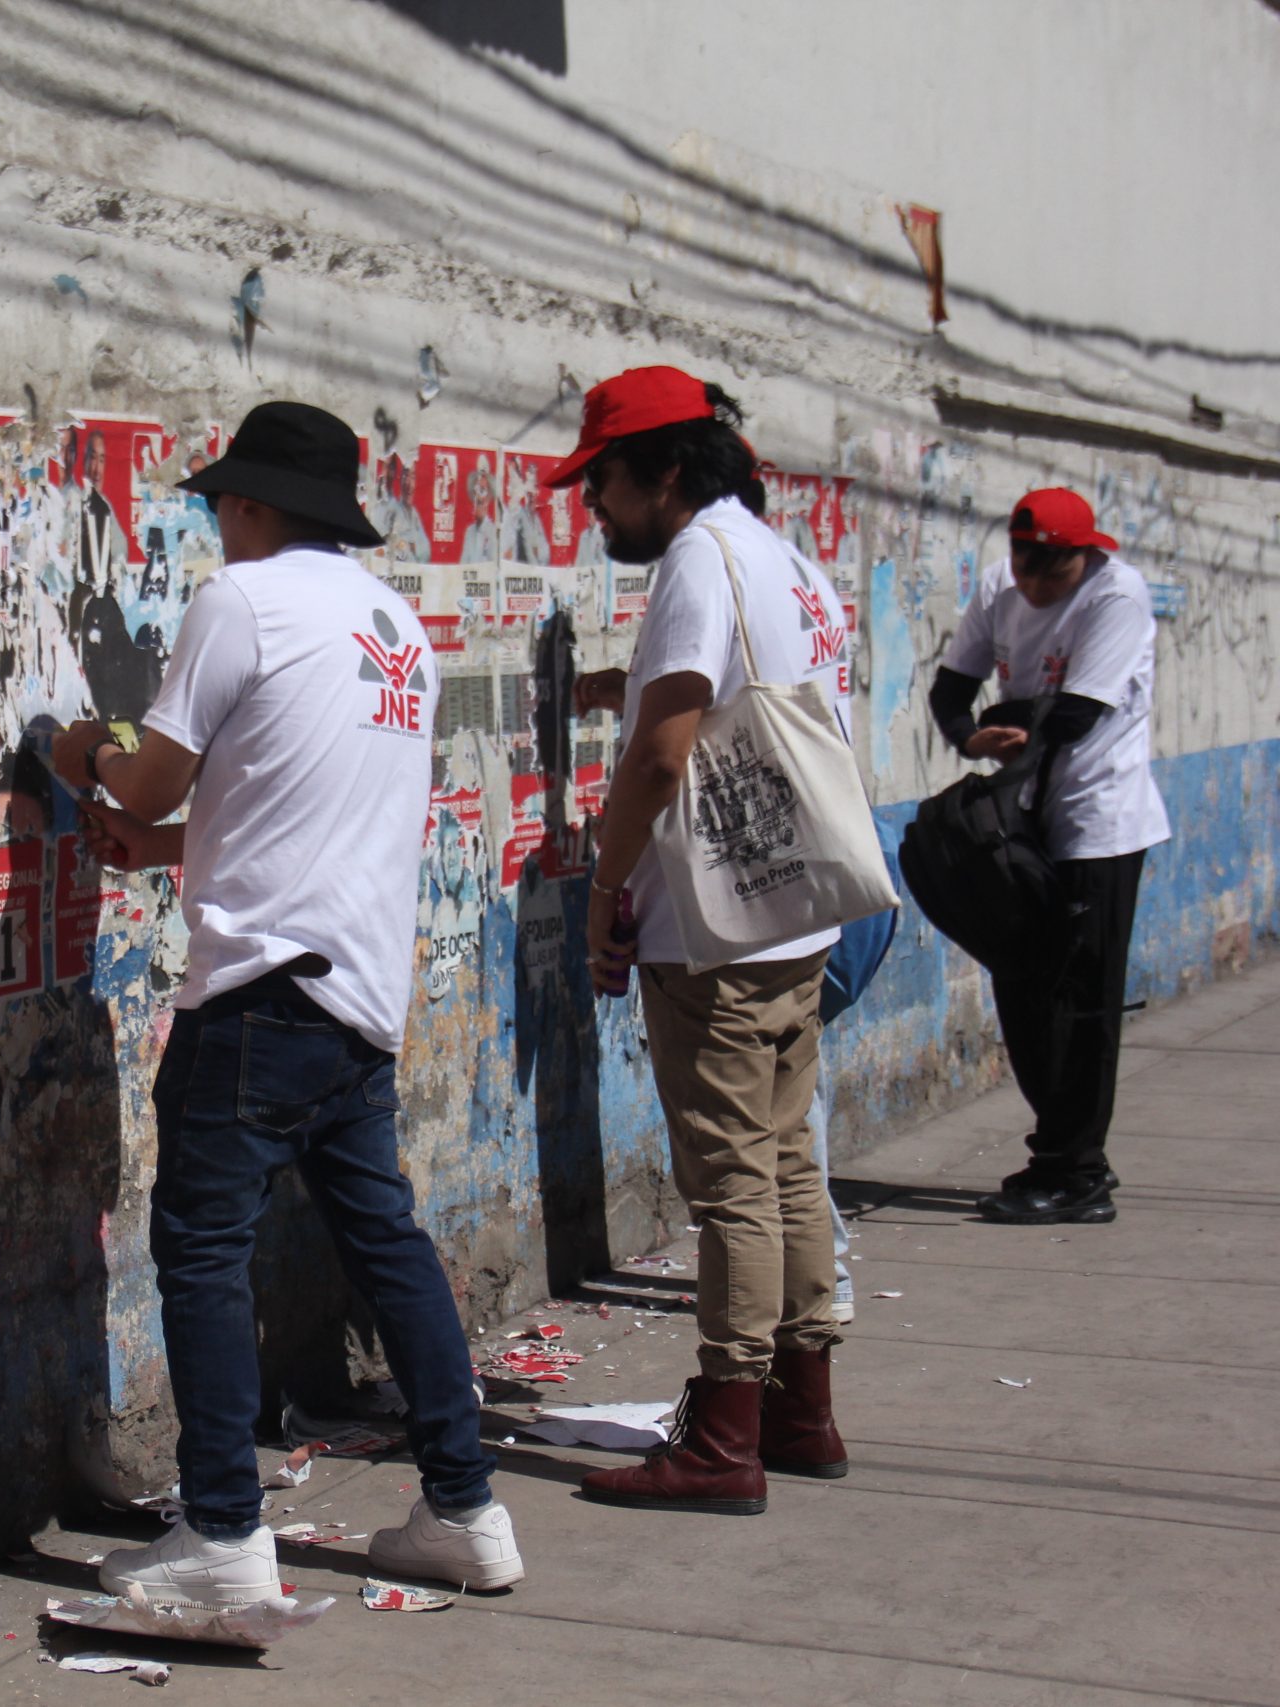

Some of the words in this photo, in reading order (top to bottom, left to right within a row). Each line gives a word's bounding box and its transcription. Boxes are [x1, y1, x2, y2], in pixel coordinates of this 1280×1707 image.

[372, 688, 420, 732] JNE
[735, 876, 768, 896] Ouro
[768, 860, 805, 883] Preto
[1, 916, 17, 983] 1
